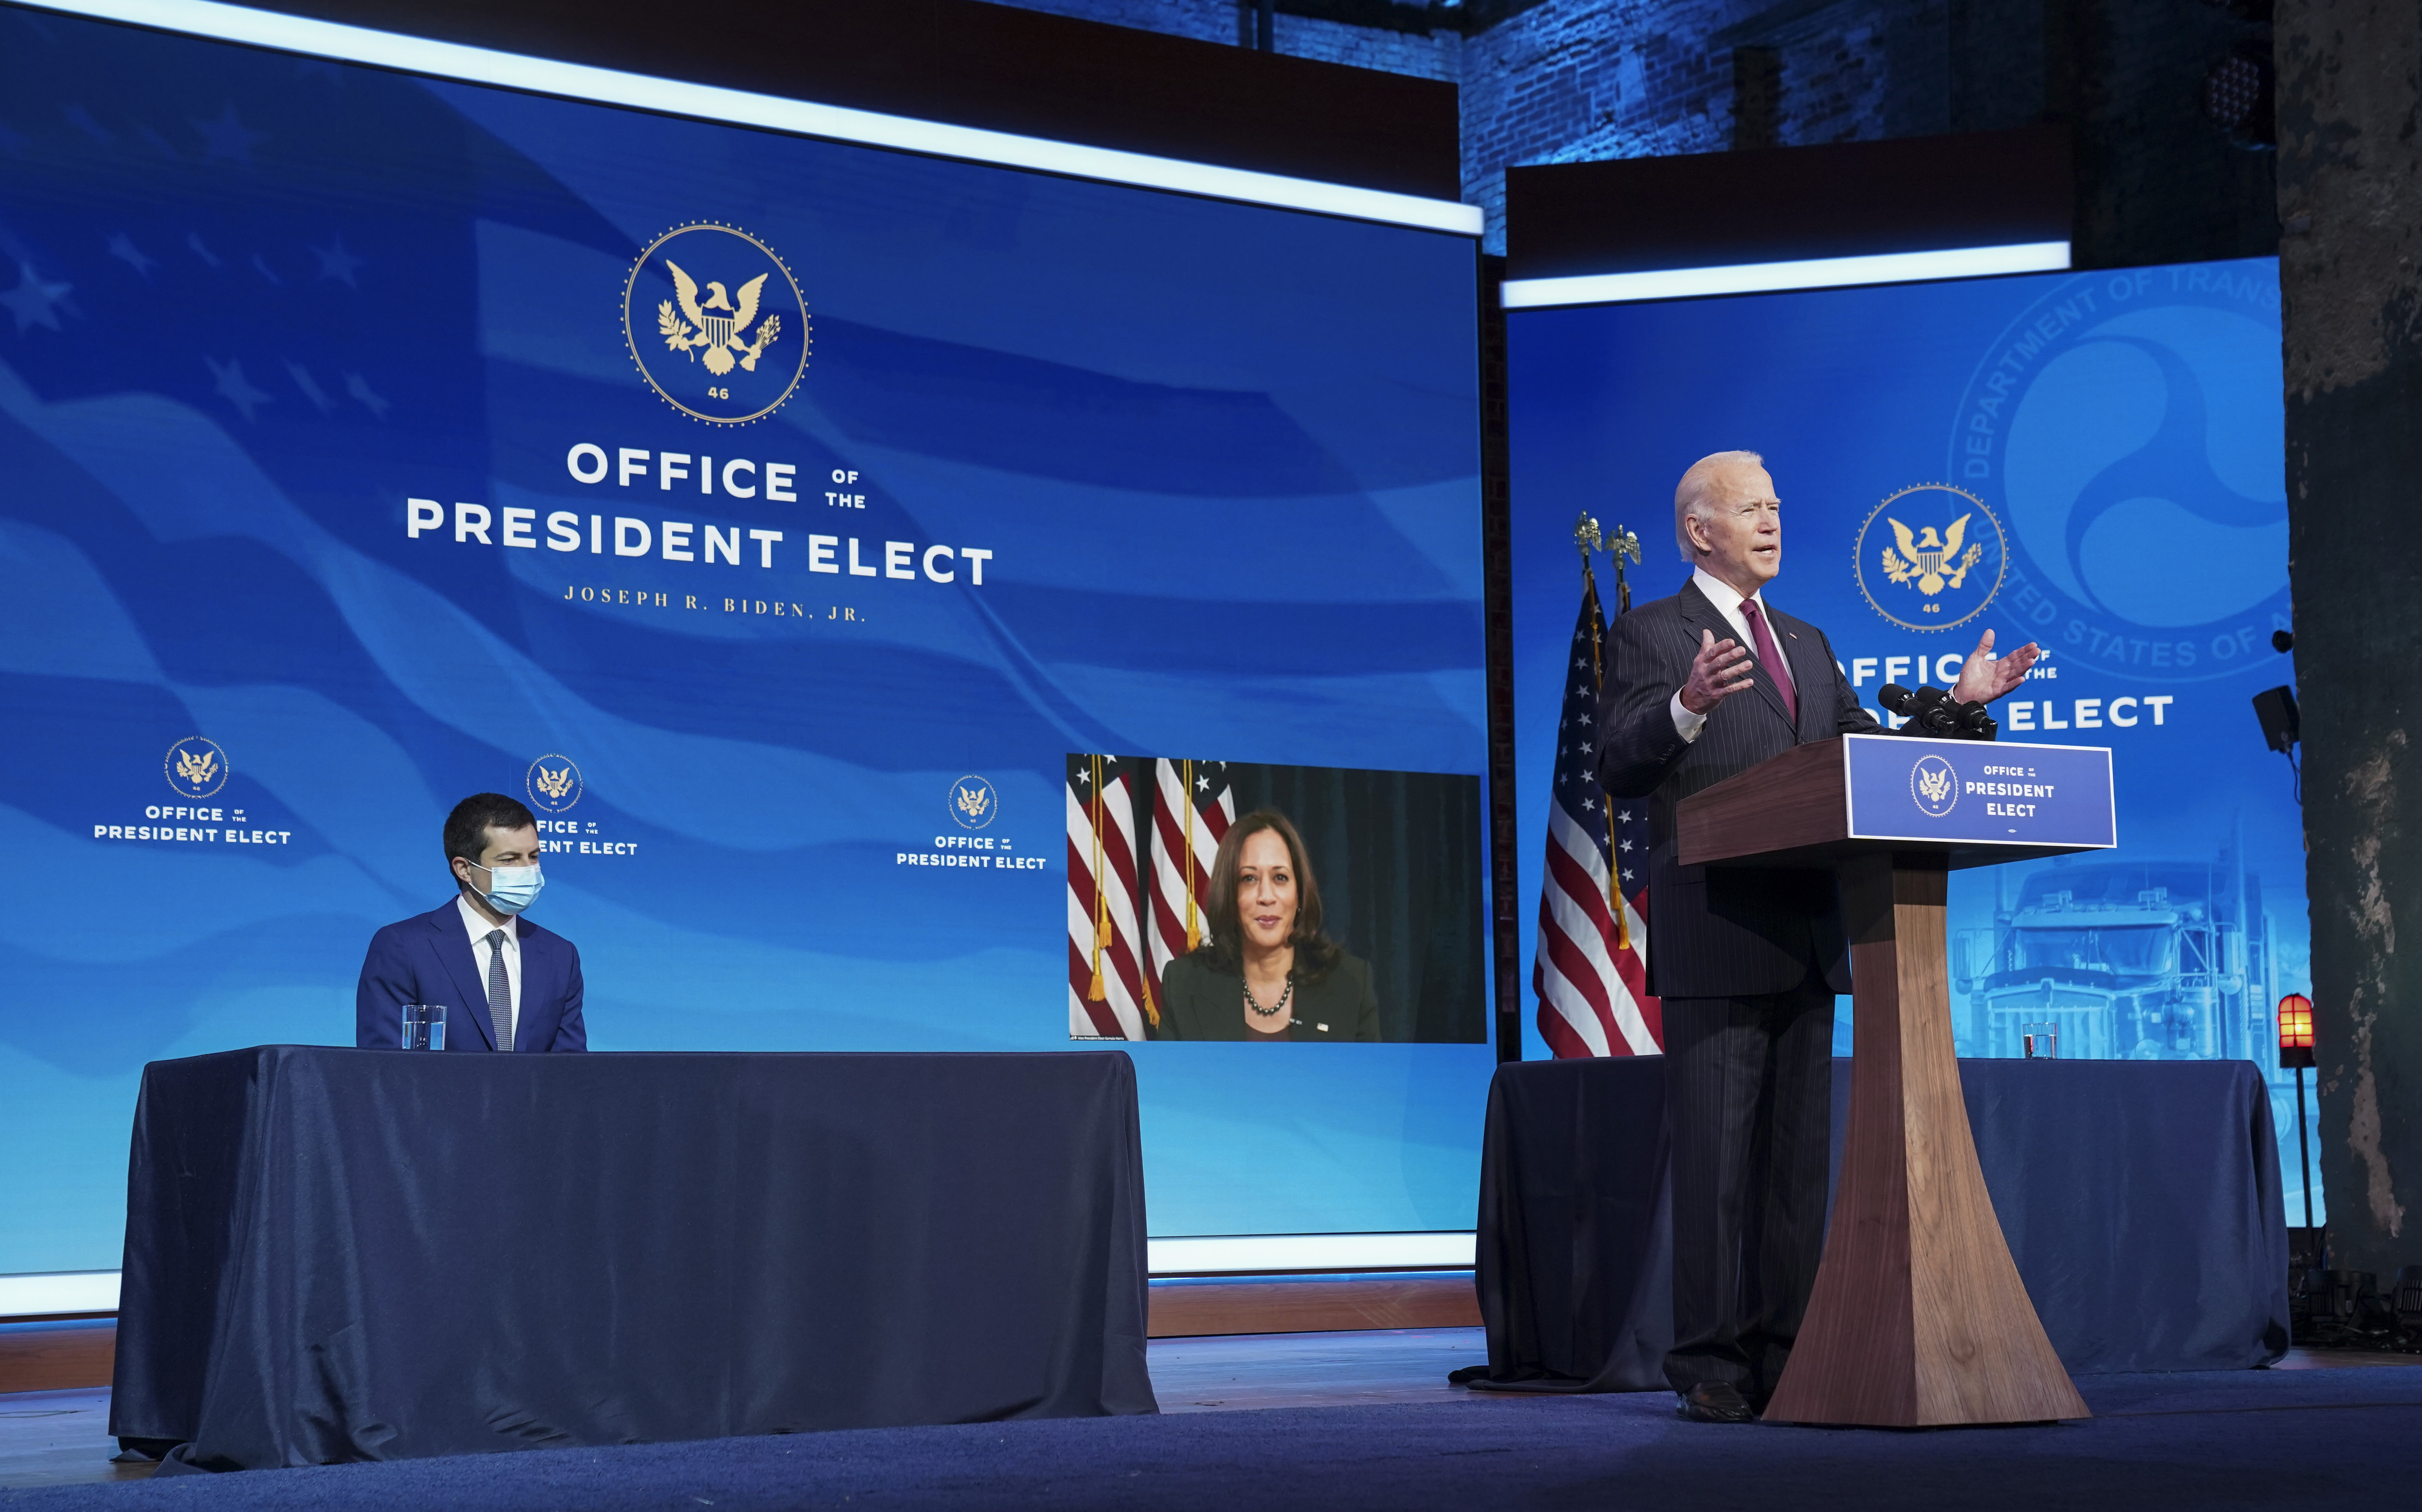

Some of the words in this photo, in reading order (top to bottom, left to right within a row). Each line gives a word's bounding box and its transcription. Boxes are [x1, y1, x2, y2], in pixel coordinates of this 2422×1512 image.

[1964, 287, 2098, 479] DEPARTMENT
[2108, 269, 2153, 302] OF
[708, 387, 729, 400] 46
[567, 443, 797, 503] OFFICE
[832, 469, 859, 485] OF
[825, 492, 866, 509] THE
[407, 498, 784, 569] PRESIDENT
[809, 534, 993, 586] ELECT
[1973, 517, 2057, 626] UNITED
[2064, 619, 2196, 668] STATES
[2212, 626, 2258, 659] OF
[564, 585, 667, 607] JOSEPH
[686, 595, 707, 610] R.
[725, 598, 812, 619] BIDEN,
[828, 606, 865, 622] JR.
[1923, 604, 1940, 613] 46
[2034, 649, 2050, 661] F
[1837, 651, 1997, 687] FFIC
[2025, 667, 2057, 680] THE
[2008, 696, 2173, 731] ELECT
[1984, 765, 2024, 776] OFFICE
[1966, 781, 2055, 798] PRESIDENT
[145, 805, 223, 822] OFFICE
[1986, 802, 2036, 817] ELECT
[94, 825, 218, 842] PRESIDENT
[226, 829, 291, 845] ELECT
[536, 820, 578, 834] FICE
[580, 841, 638, 856] ELECT
[935, 836, 994, 849] OFFICE
[897, 853, 991, 868] PRESIDENT
[996, 856, 1046, 870] ELECT
